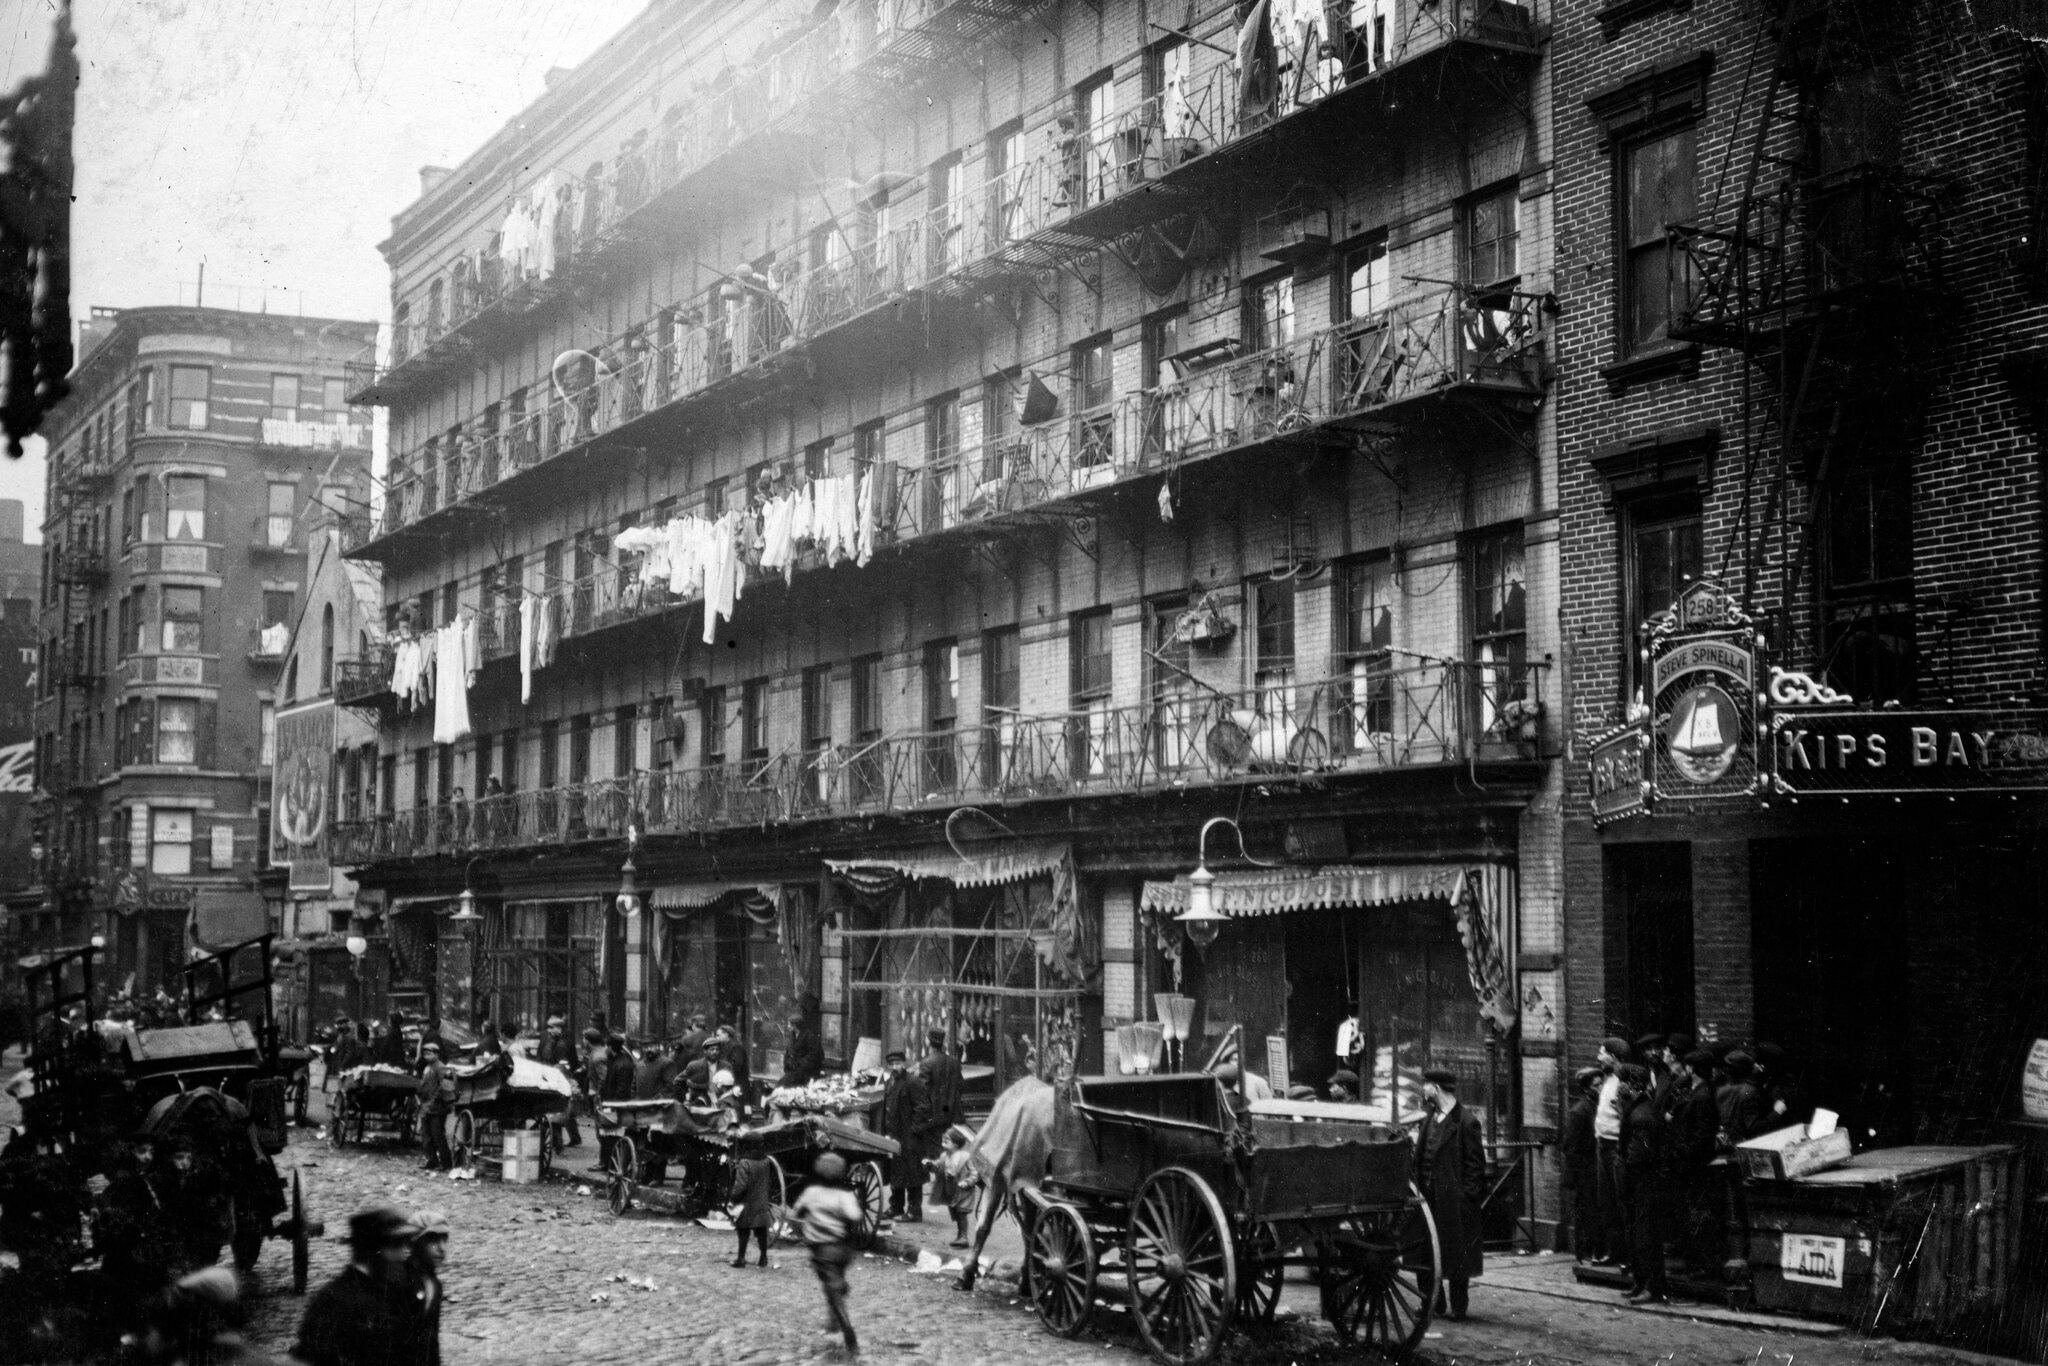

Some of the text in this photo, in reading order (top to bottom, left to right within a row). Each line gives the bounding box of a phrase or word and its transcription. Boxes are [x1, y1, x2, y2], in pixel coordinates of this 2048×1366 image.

[1689, 598, 1714, 617] 258
[1660, 648, 1744, 679] STEVE SPINELLA
[1783, 726, 1995, 771] KIPS BAY
